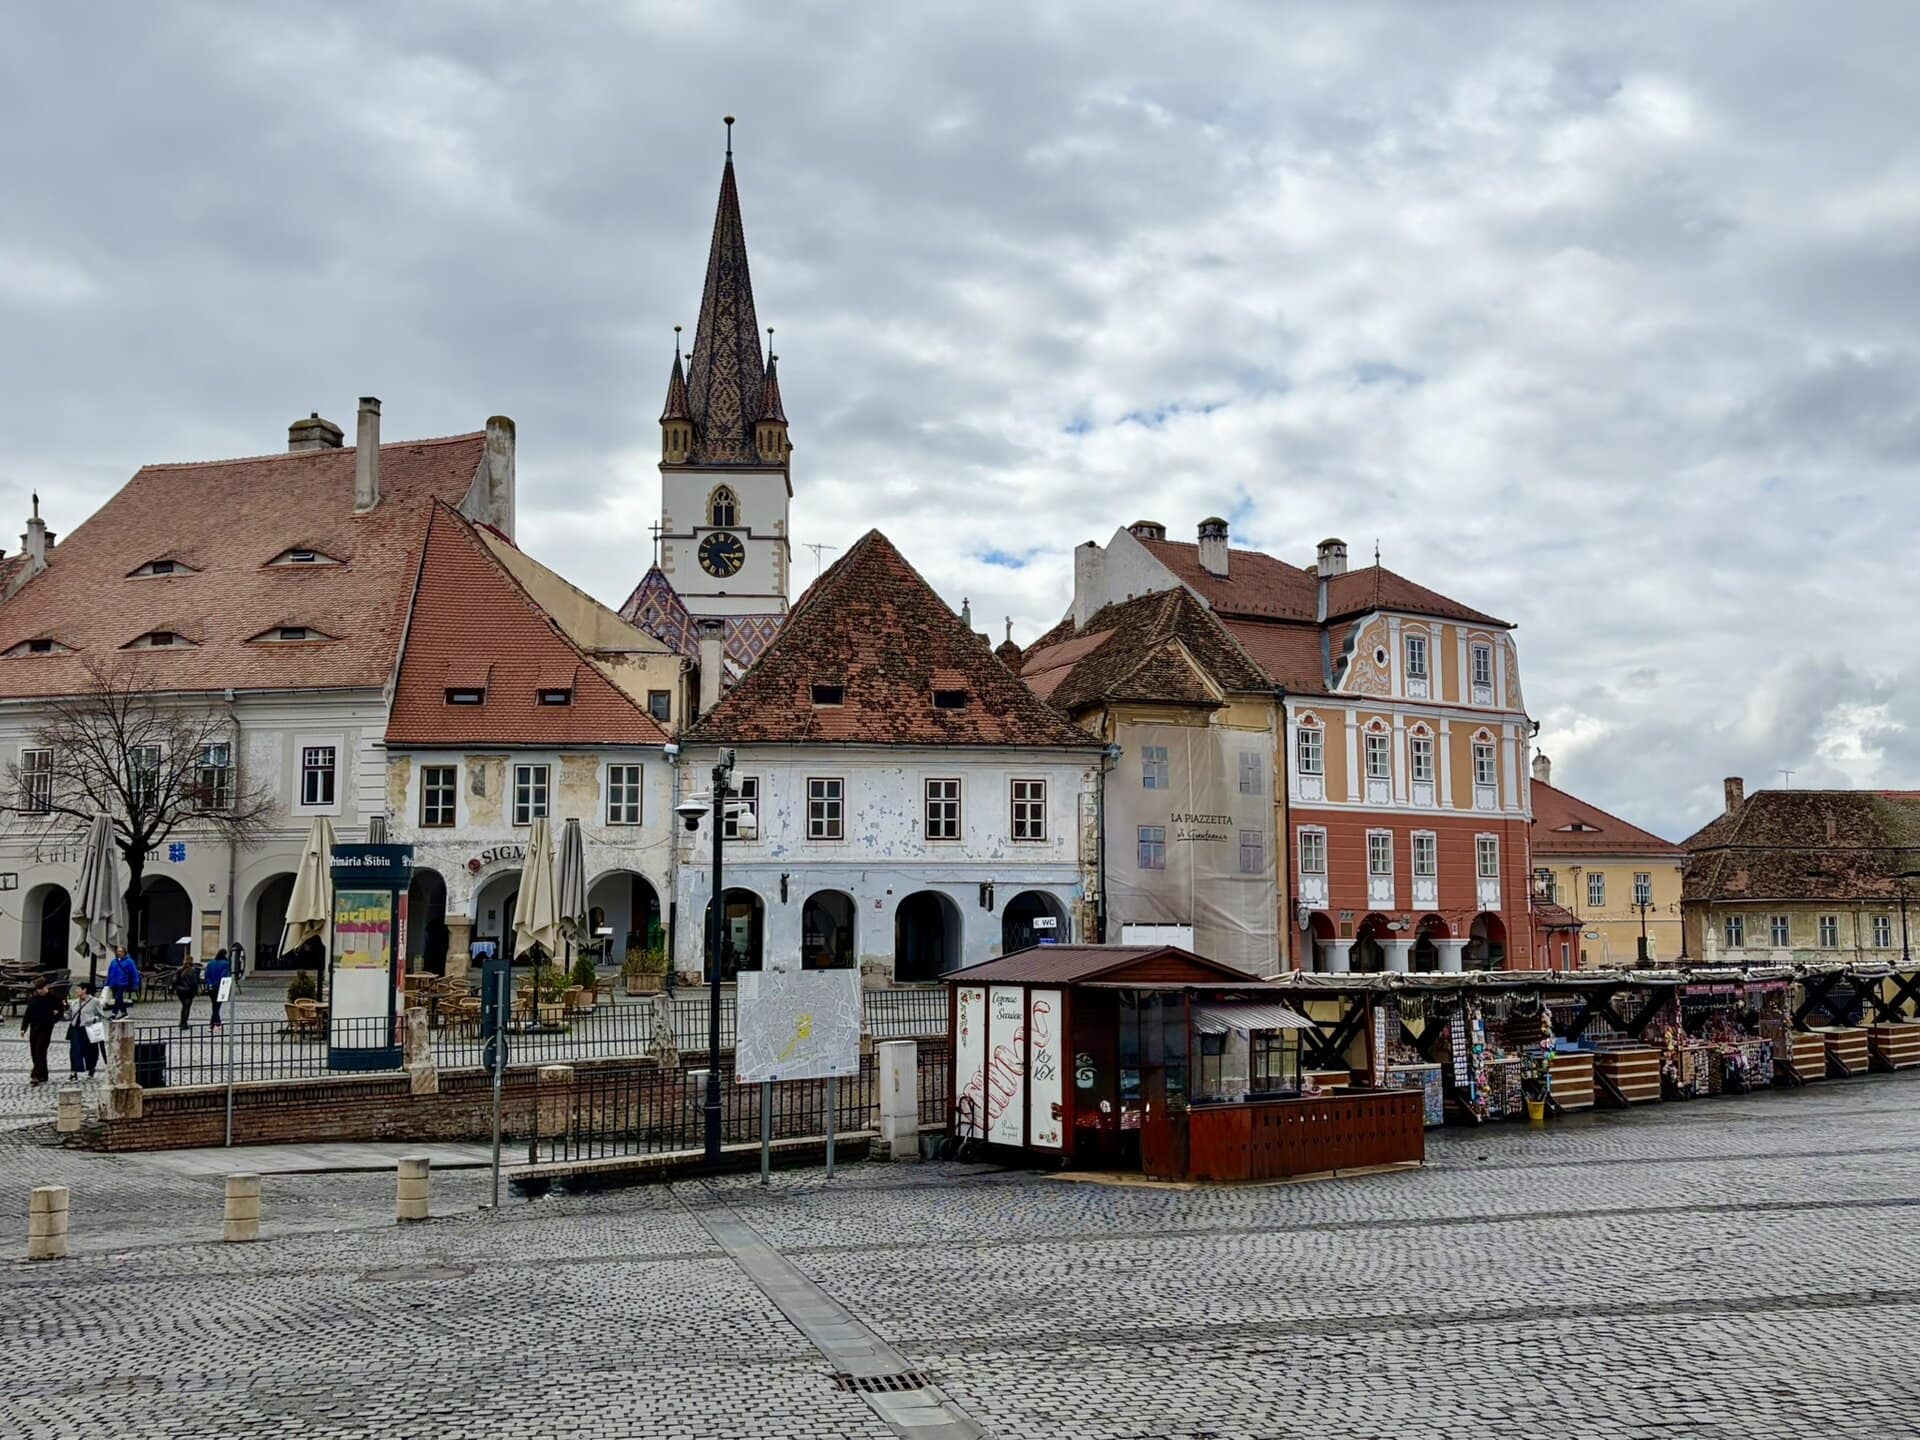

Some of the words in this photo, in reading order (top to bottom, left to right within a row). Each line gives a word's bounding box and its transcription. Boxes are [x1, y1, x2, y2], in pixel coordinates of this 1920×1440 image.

[1171, 813, 1183, 823] LA
[1184, 814, 1233, 825] PIAZZETTA
[362, 854, 391, 867] Sibiu
